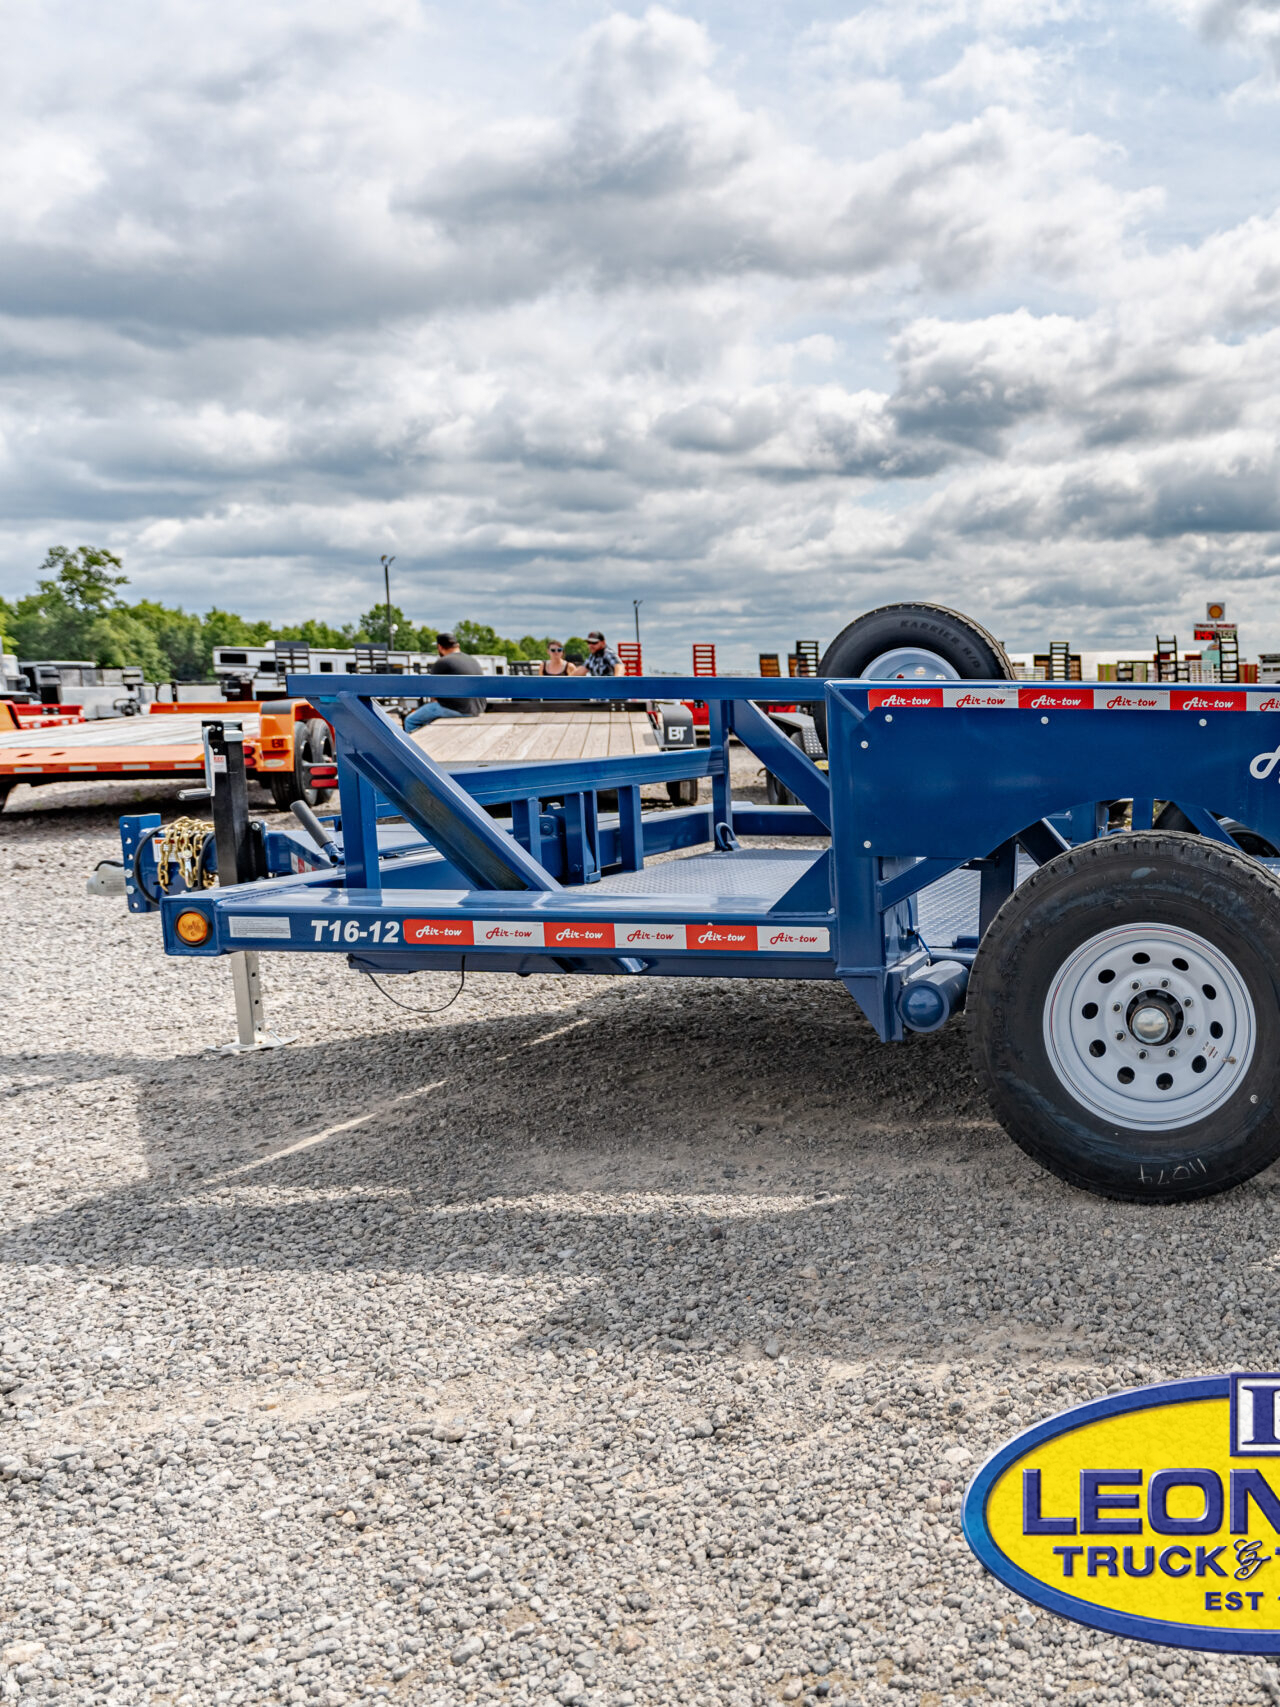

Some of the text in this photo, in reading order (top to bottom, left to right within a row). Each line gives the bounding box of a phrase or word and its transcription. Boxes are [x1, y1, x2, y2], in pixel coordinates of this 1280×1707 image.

[901, 620, 960, 645] KARRIER
[881, 694, 931, 708] Air-tow
[956, 694, 1005, 708] Air-tow
[1031, 694, 1081, 708] Air-tow
[1106, 695, 1157, 709] Air-tow
[1182, 696, 1234, 710] Air-tow
[668, 726, 688, 742] BT
[310, 919, 400, 944] T16-12
[415, 924, 818, 945] Air-tow Air-tow Air-tow Air-tow Air-tow Air-tow
